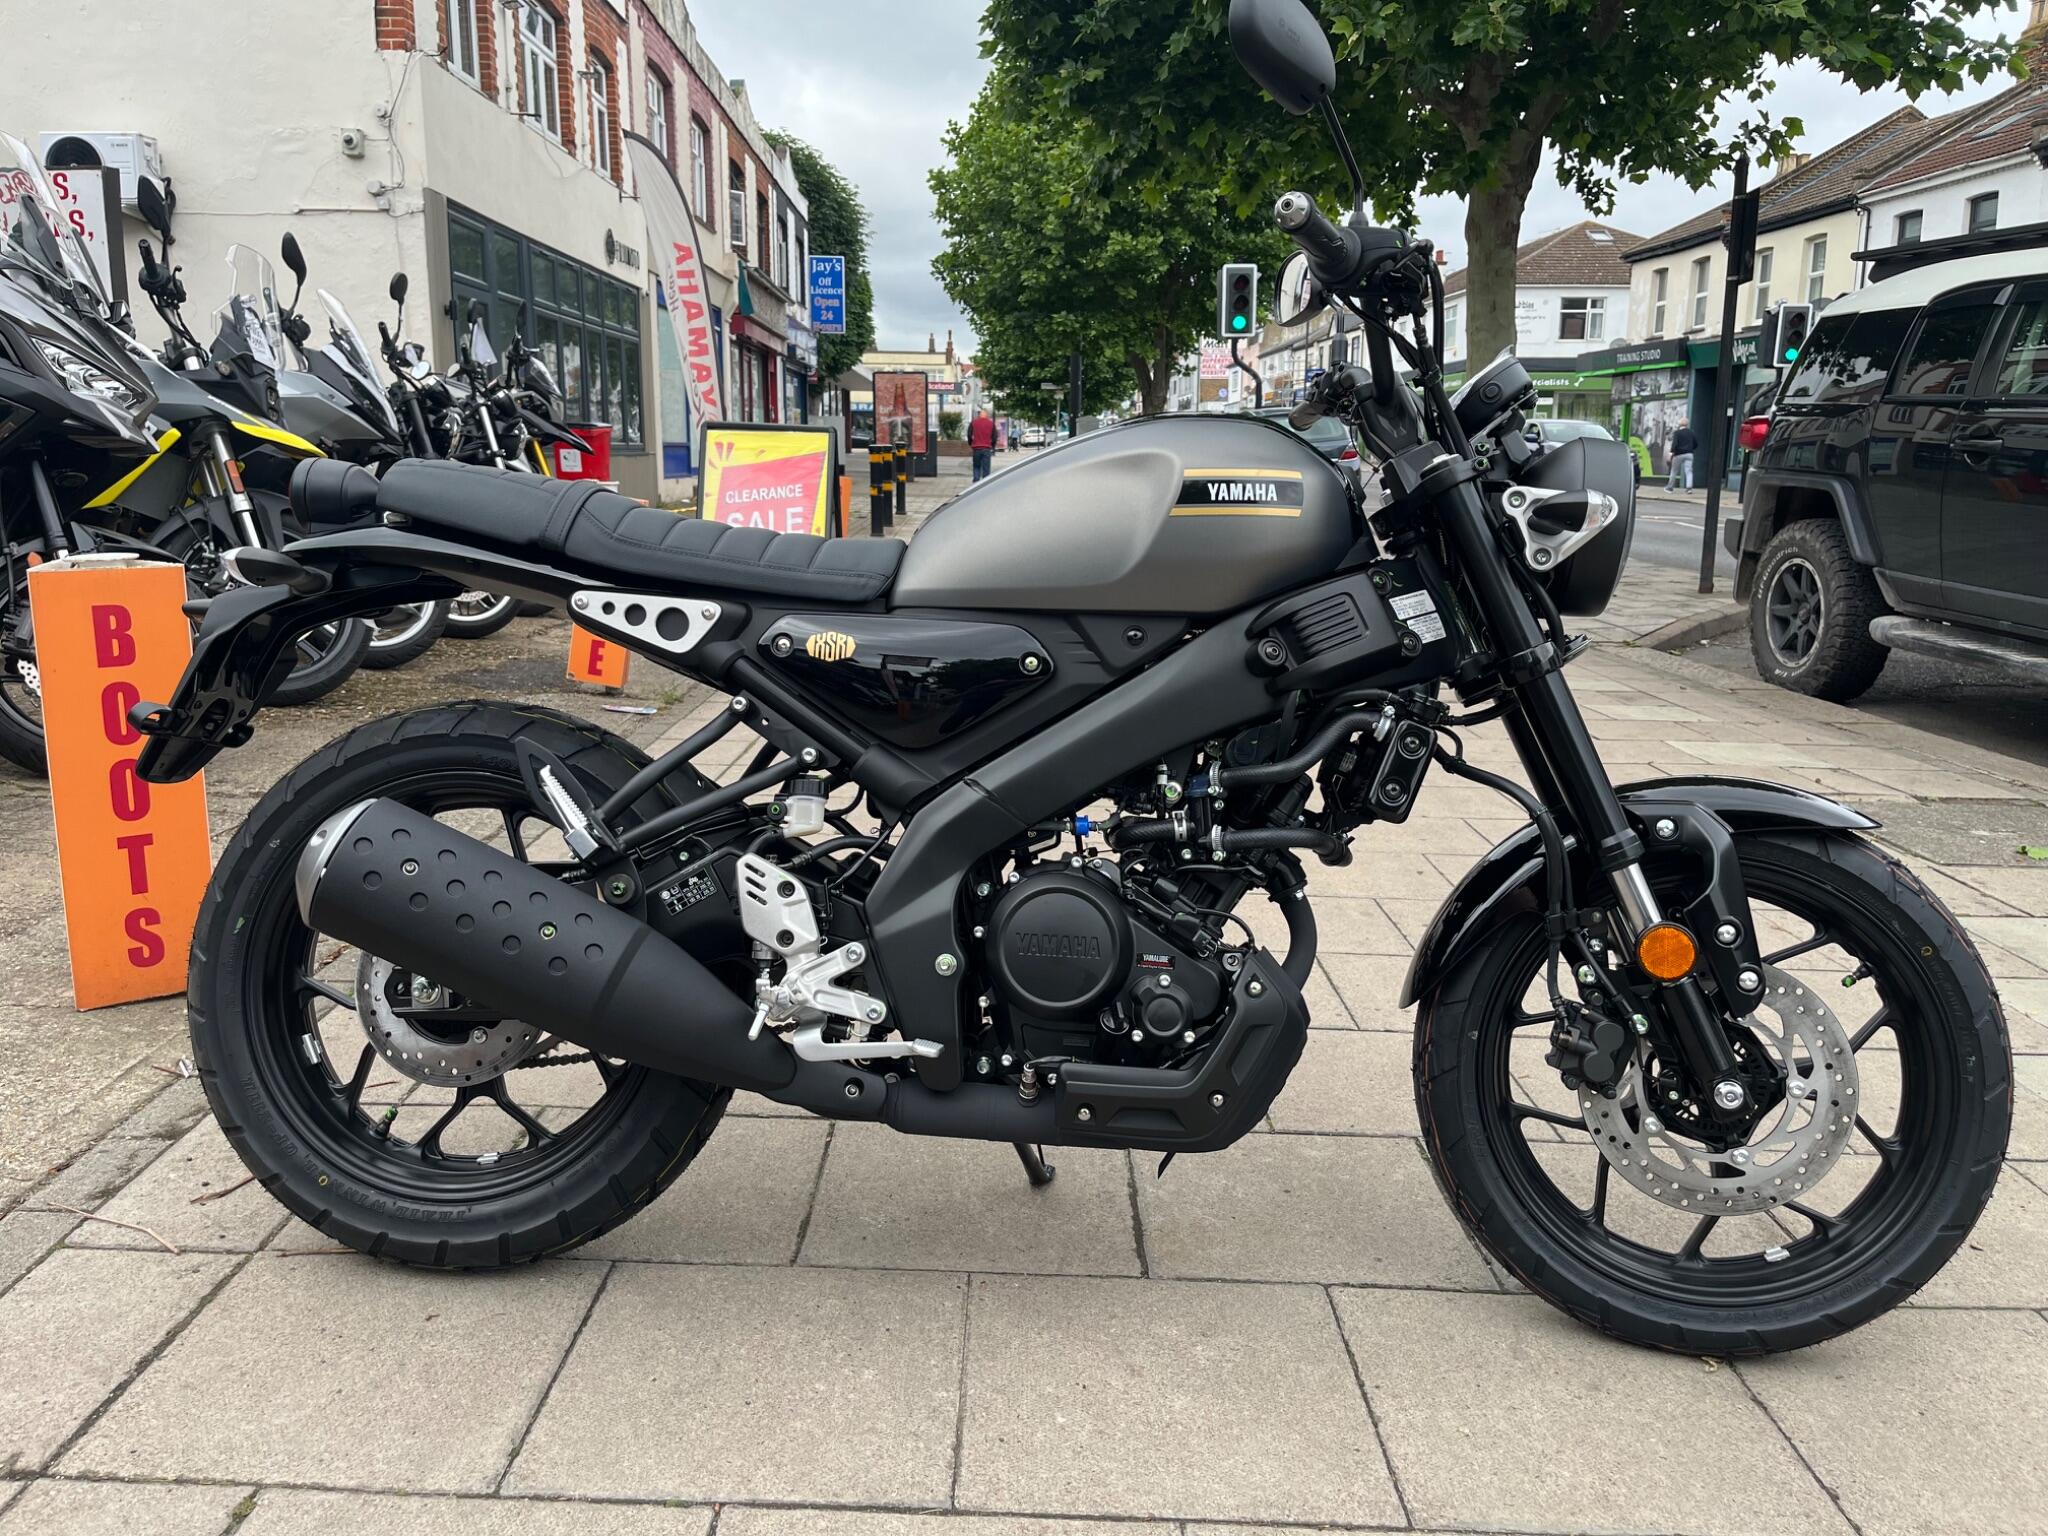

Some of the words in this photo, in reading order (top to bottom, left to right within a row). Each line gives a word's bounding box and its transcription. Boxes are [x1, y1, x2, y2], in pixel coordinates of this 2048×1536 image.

[812, 259, 841, 274] Jay's
[810, 285, 843, 295] Licence
[814, 297, 840, 309] Open
[820, 310, 834, 321] 24
[1616, 351, 1641, 364] TRAINING
[1640, 349, 1661, 360] STUDIO
[725, 483, 804, 505] CLEARANCE
[1207, 482, 1278, 502] YAMAHA
[726, 506, 805, 535] SALE
[806, 631, 856, 662] XSR
[90, 604, 166, 969] BOOTS
[1015, 932, 1101, 960] YAMAHA
